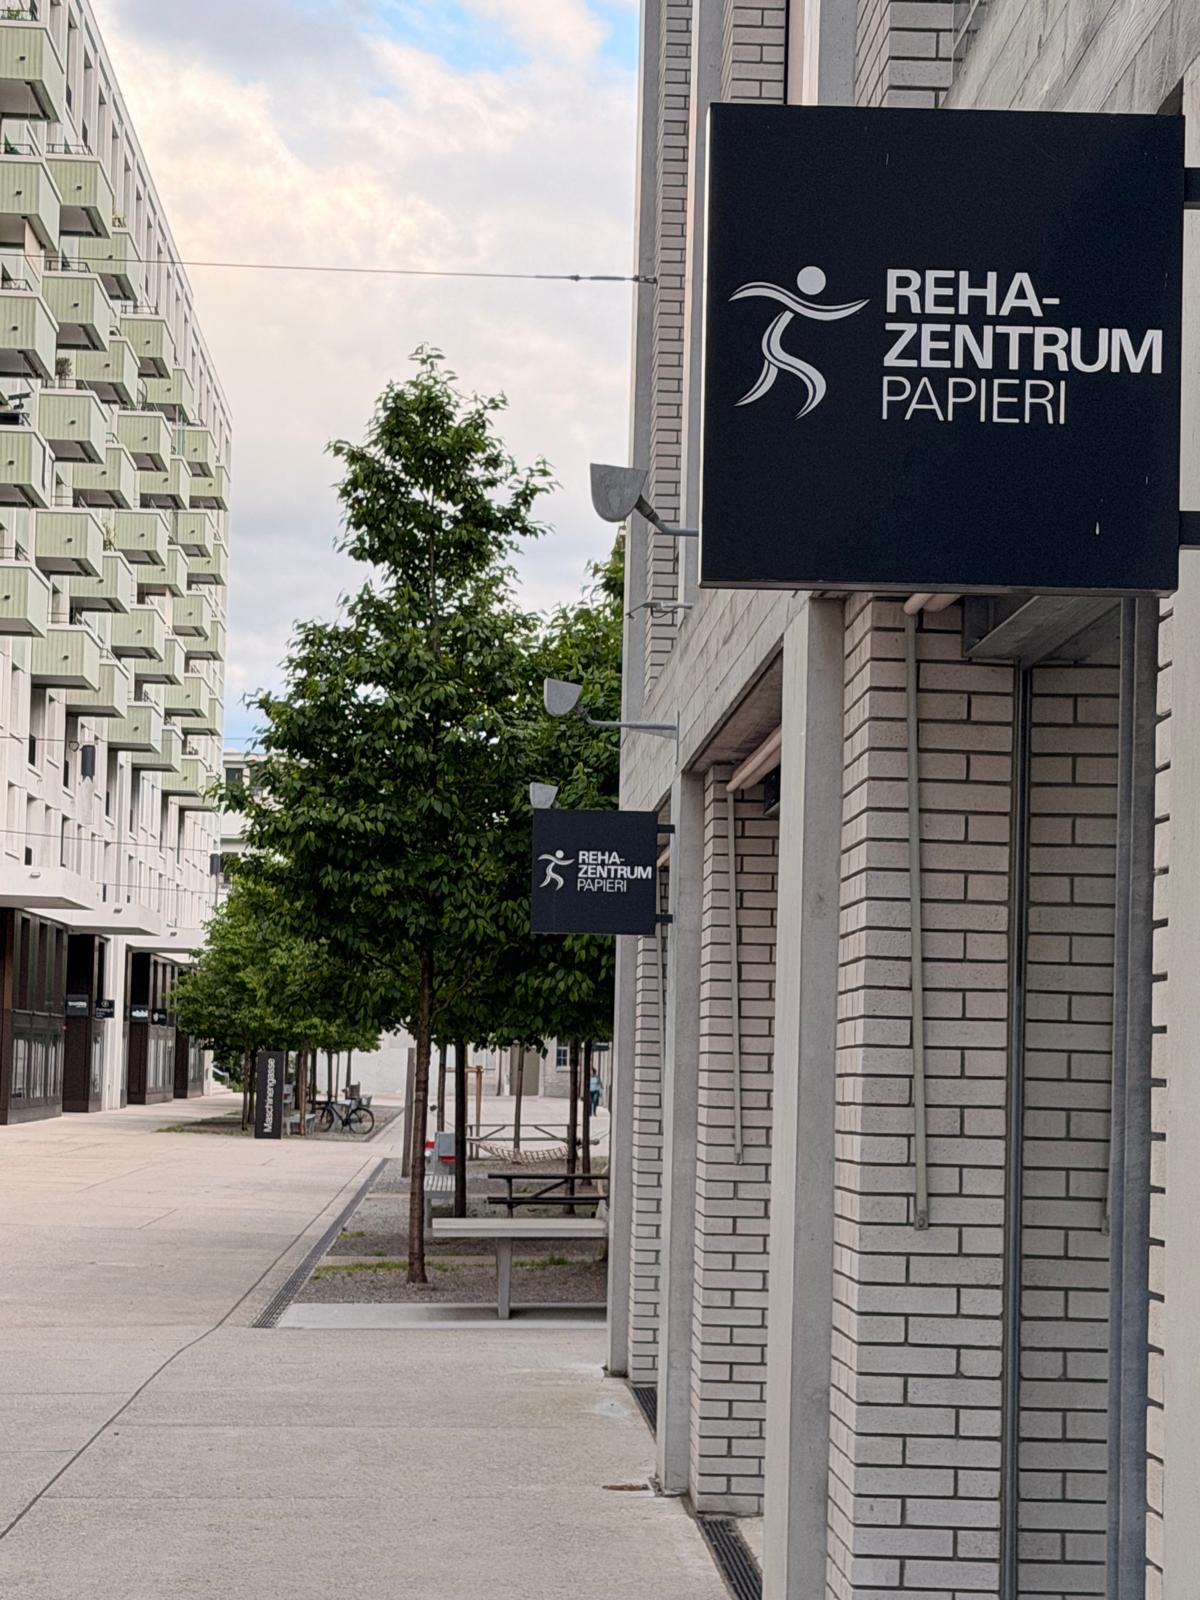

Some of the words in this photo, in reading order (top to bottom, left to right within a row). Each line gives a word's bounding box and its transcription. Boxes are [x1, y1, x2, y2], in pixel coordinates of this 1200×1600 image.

[886, 268, 1060, 317] REHA-
[883, 322, 1163, 374] ZENTRUM
[881, 376, 1066, 425] PAPIERI
[577, 865, 652, 879] ZENTRUM
[578, 850, 625, 864] REHA-
[576, 879, 627, 893] PAPIERI
[263, 1057, 276, 1133] Maschinengasse
